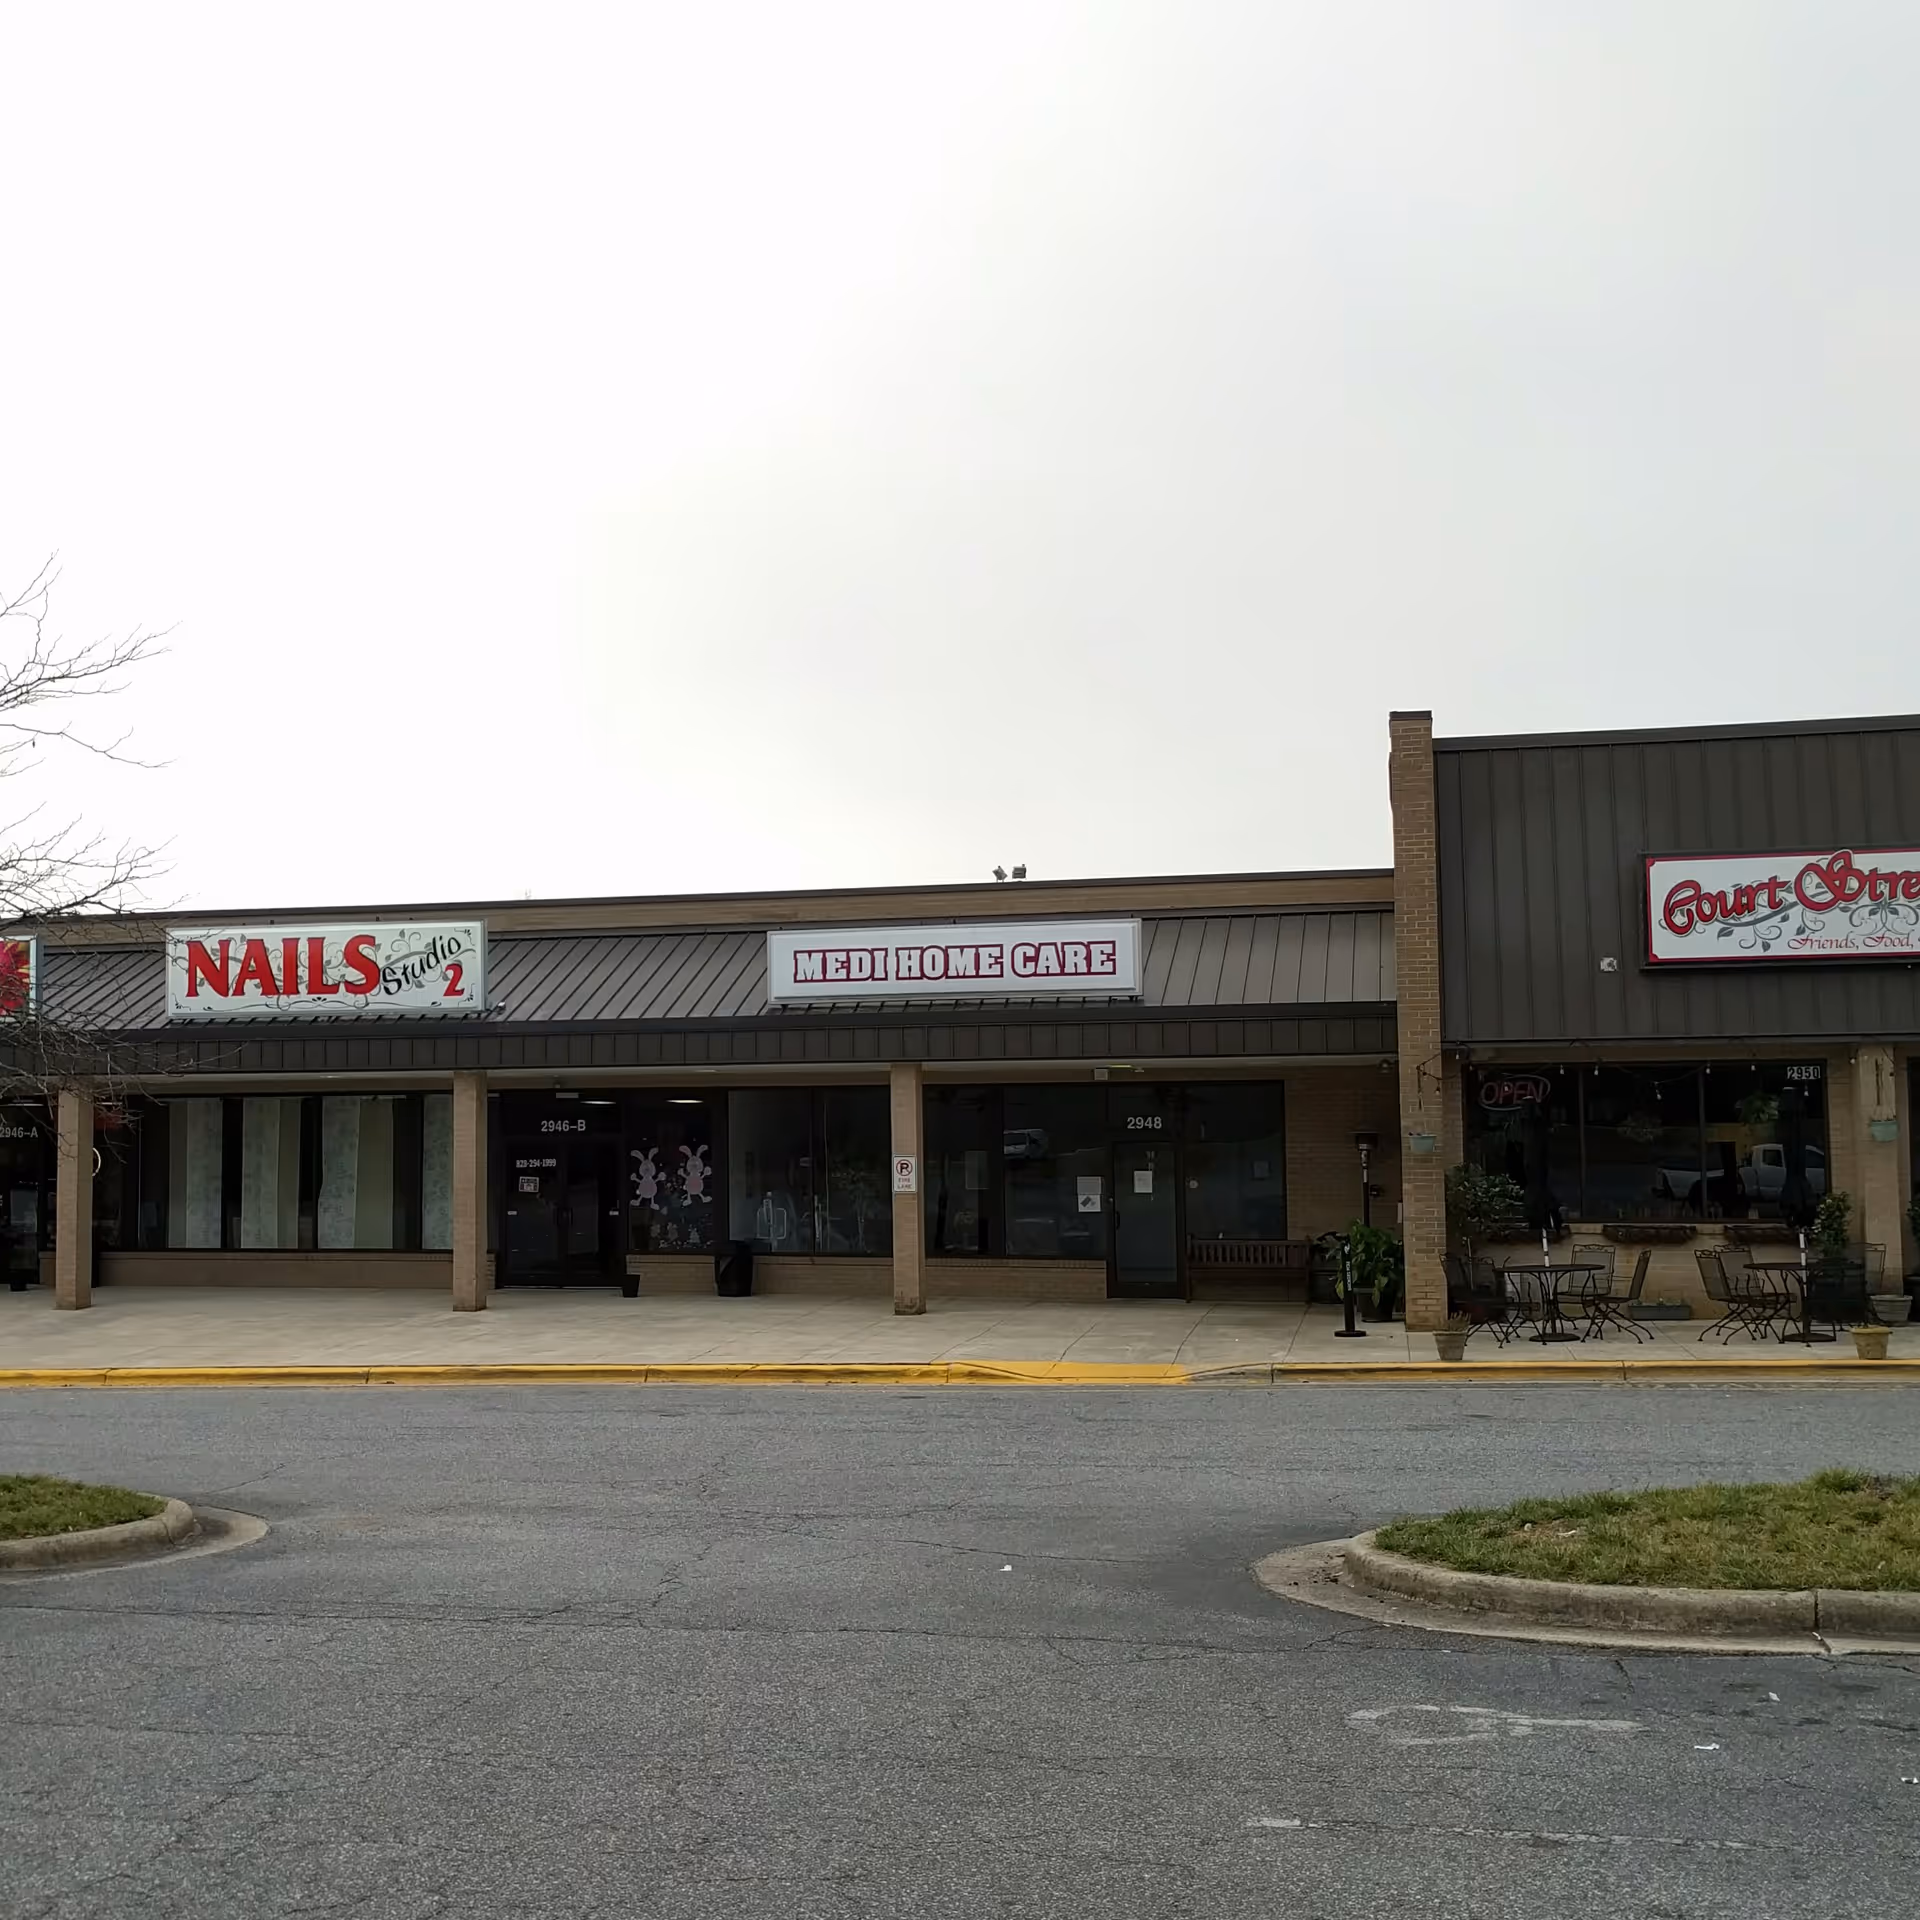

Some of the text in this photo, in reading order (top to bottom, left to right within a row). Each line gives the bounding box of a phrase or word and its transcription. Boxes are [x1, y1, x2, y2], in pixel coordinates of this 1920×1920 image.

[1663, 876, 1793, 935] Court
[1787, 930, 1914, 950] Friends, Food,
[185, 934, 462, 998] NAILS Studio
[793, 940, 1117, 983] MEDI HOME CARE
[443, 963, 465, 997] 2
[1787, 1066, 1820, 1080] 2950
[1481, 1081, 1544, 1105] OPEN
[0, 1126, 39, 1138] 2946-A
[541, 1119, 586, 1132] 2946-B
[1127, 1116, 1162, 1129] 2948
